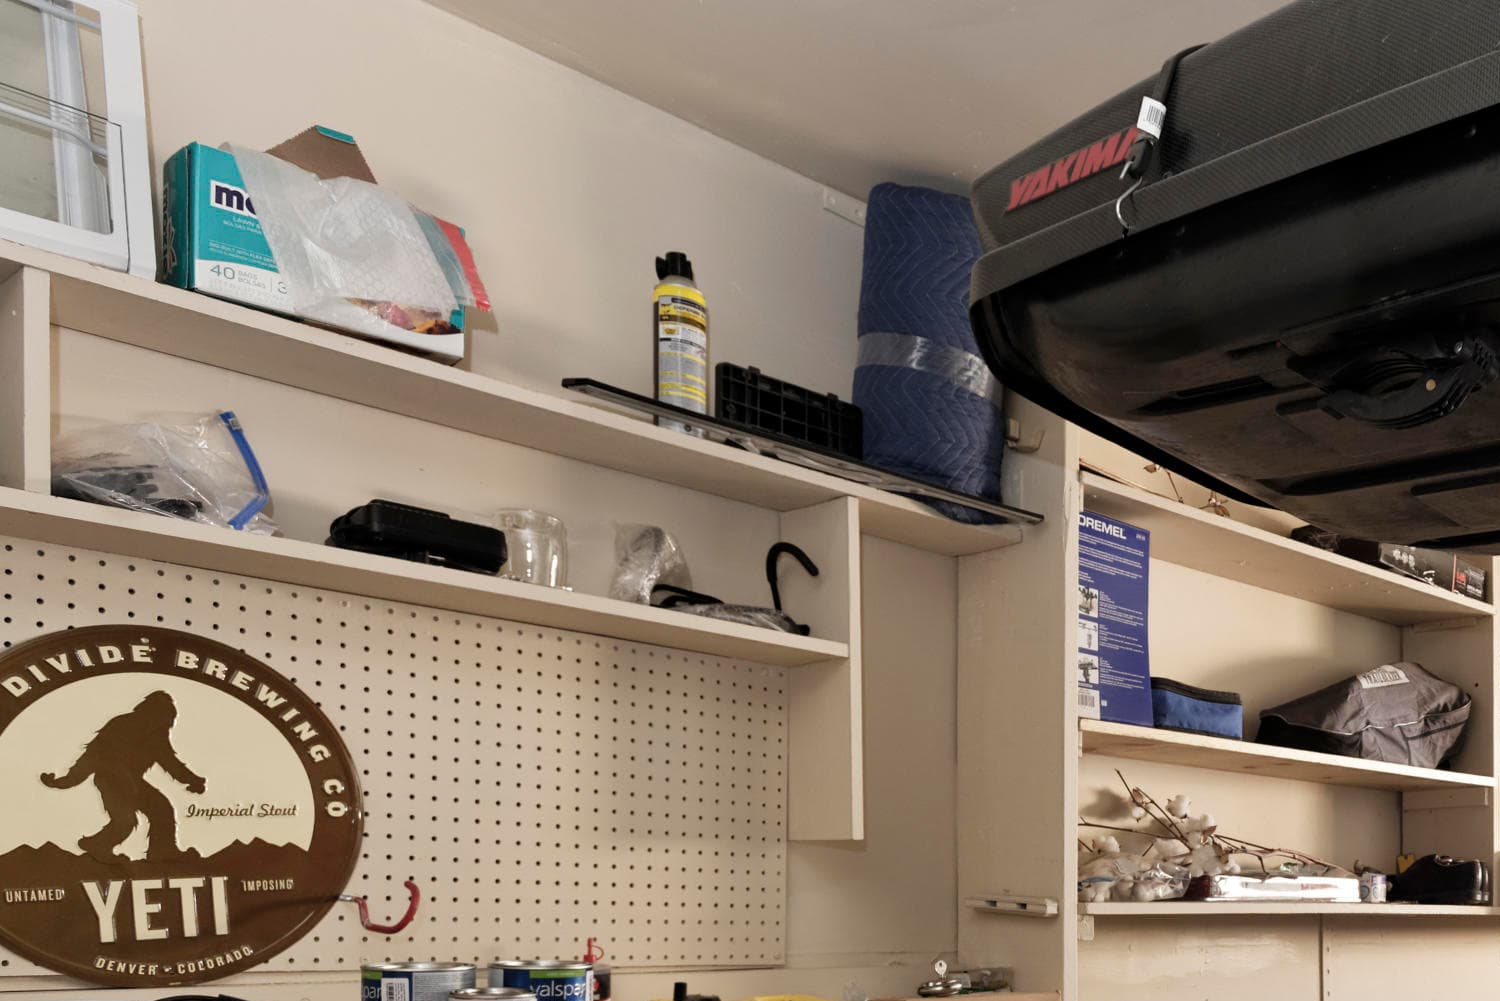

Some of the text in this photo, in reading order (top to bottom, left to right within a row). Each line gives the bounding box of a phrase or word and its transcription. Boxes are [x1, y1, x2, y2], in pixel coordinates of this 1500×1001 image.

[209, 264, 236, 280] 40
[1079, 515, 1128, 540] DREMEL
[1, 643, 349, 819] DIVIDE BREWING CO
[185, 803, 297, 820] Imperial Stout
[5, 876, 294, 943] UNTAMED YETI IMPOSING
[96, 945, 254, 976] DENVER COLORADO
